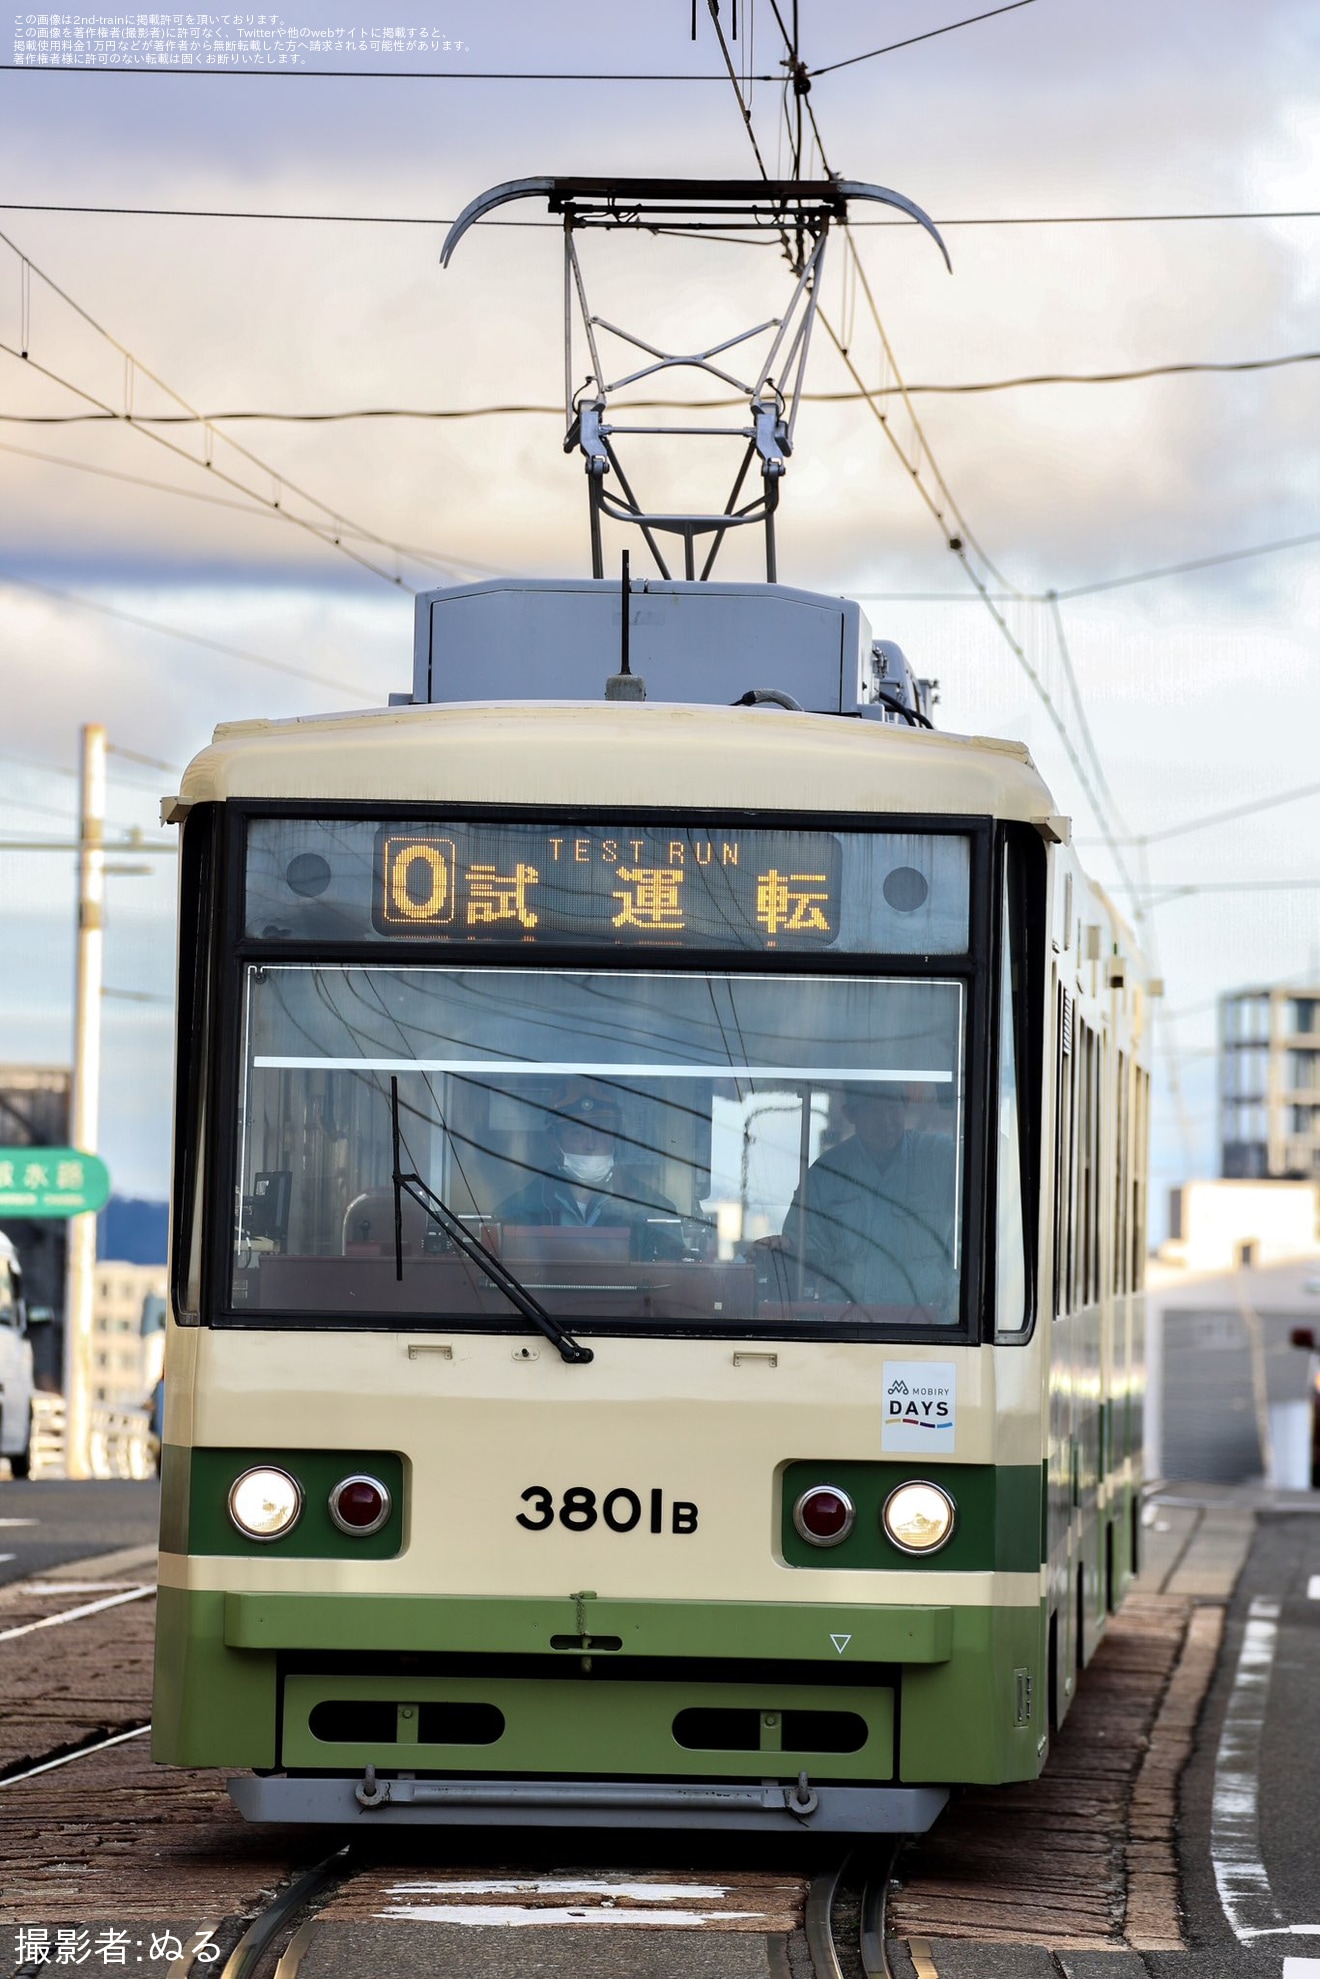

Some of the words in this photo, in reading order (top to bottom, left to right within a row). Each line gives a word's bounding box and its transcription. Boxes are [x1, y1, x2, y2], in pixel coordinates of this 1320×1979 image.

[549, 838, 644, 863] TEST
[669, 839, 739, 865] RUN
[912, 1387, 949, 1396] MOBIRY
[889, 1400, 949, 1417] DAYS
